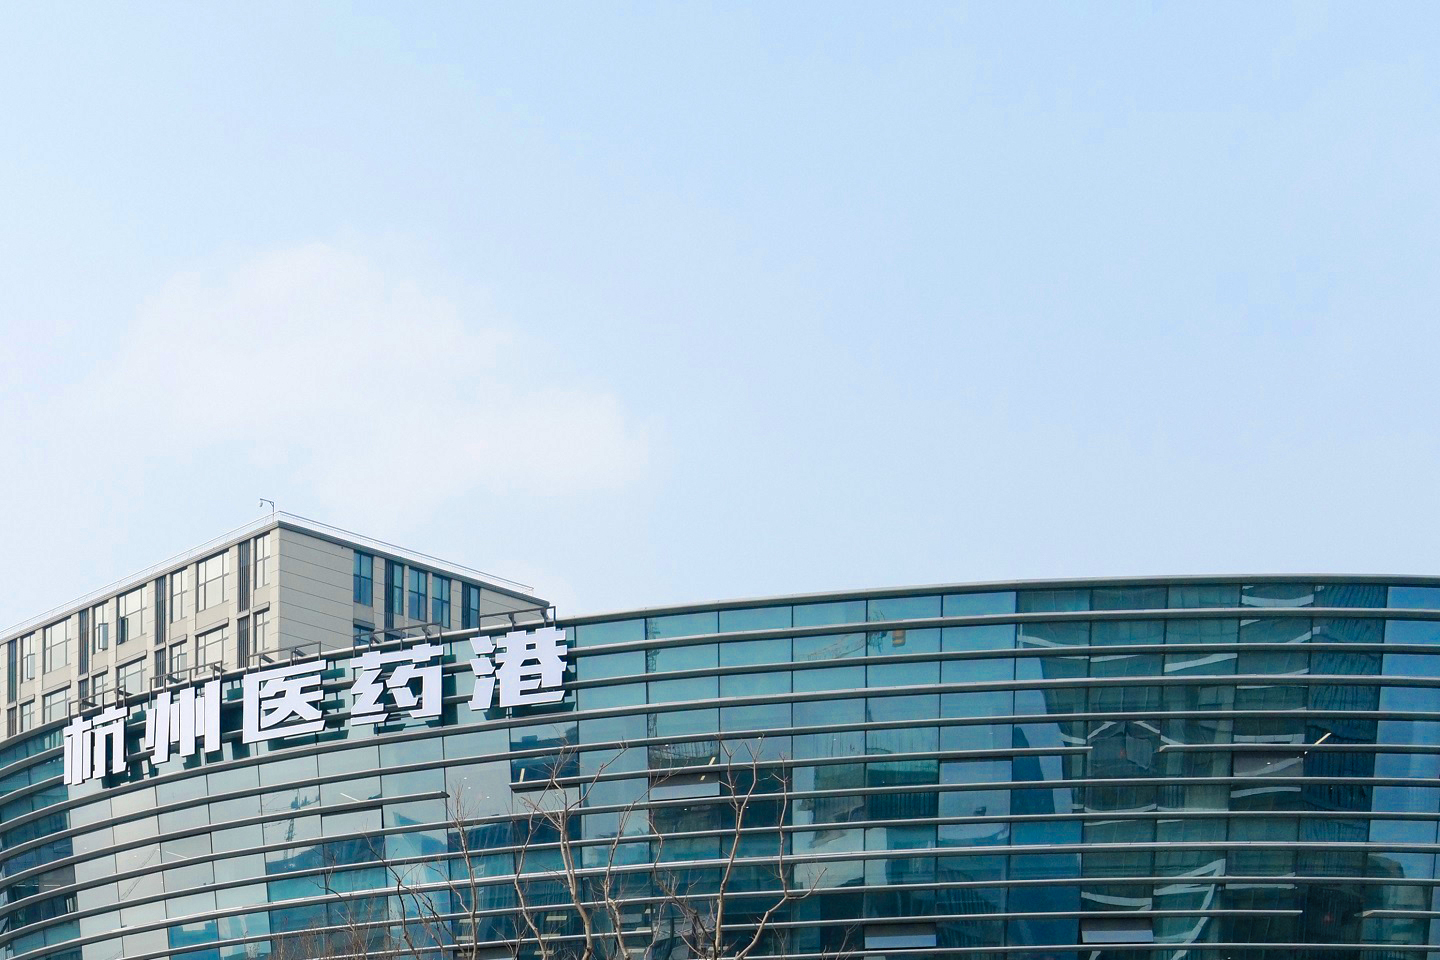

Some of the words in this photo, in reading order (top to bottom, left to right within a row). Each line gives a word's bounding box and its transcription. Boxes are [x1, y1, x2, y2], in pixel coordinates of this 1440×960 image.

[63, 626, 568, 786] 杭州医药港
